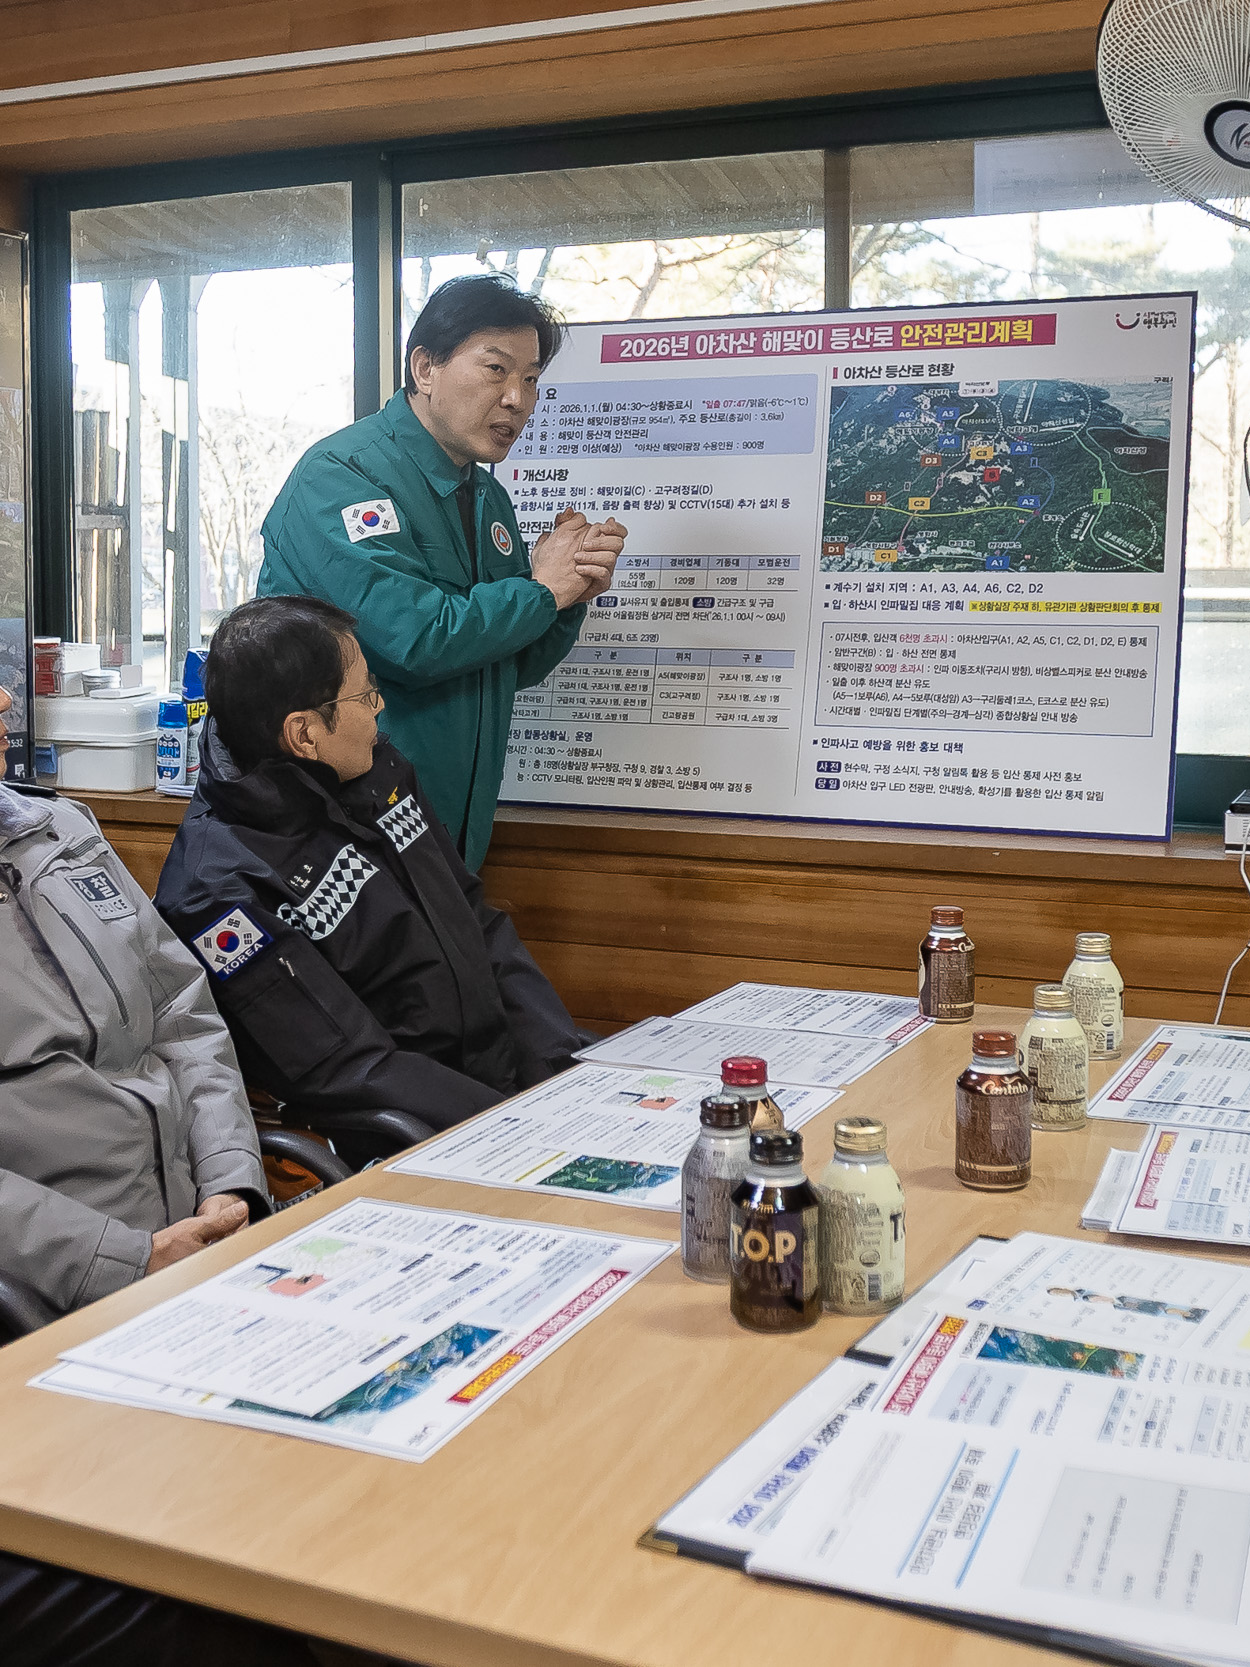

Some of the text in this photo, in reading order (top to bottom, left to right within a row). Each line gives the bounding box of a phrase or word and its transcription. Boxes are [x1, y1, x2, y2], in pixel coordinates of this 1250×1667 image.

[620, 319, 1032, 356] 2026년 아차산 해맞이 등산로 안전관리계획
[844, 363, 954, 379] 아차산 등산로 현황
[545, 388, 557, 400] 요
[559, 402, 612, 412] 2026.1.1.(월)
[615, 399, 692, 411] 04:30~상황종료시
[559, 416, 584, 426] 아차산
[587, 416, 645, 426] 해맞이광장(규모
[678, 413, 696, 423] 주요
[699, 412, 751, 423] 등산로(총길이
[558, 428, 648, 440] 해맞이 등산객 안전관리
[522, 468, 569, 482] 개선사항
[520, 484, 712, 497] 노후 등산로 정비 해맞이길(C) 고구려정길(D)
[520, 501, 554, 511] 음향시설
[602, 500, 618, 510] 음량
[623, 500, 639, 510] 출력
[643, 499, 664, 510] 향상)
[668, 500, 676, 509] 및
[680, 498, 733, 509] CCTV(15대)
[737, 498, 755, 508] 추가
[759, 498, 777, 508] 설치
[781, 498, 790, 508] 등
[519, 521, 556, 534] 안전관
[625, 559, 650, 567] 소방서
[715, 558, 740, 567] 기동대
[757, 558, 791, 568] 모범운전
[833, 582, 1042, 593] 계수기 설치 지역 A1, A3, A4, A6, C2, D2
[880, 600, 918, 610] 인파밀집
[922, 600, 940, 610] 대응
[944, 600, 963, 610] 계획
[835, 633, 870, 642] 07시전후,
[873, 633, 896, 642] 입산객
[922, 634, 947, 643] 초과시
[957, 634, 1013, 644] 아차산입구(A1,
[1016, 635, 1029, 645] A2,
[1032, 636, 1046, 645] A5,
[1049, 636, 1063, 645] C1,
[1066, 636, 1080, 645] C2,
[1083, 636, 1097, 646] D1,
[1100, 637, 1114, 646] D2,
[1117, 636, 1126, 646] E)
[1129, 637, 1146, 646] 통제
[821, 737, 963, 753] 인파사고 예방을 위한 홍보 대책
[842, 780, 1103, 801] 아차산 입구 LED 전광판, 안내방송, 확성기를 활용한 입산 통제 알림
[223, 942, 263, 975] KOREA
[731, 1223, 797, 1264] T.O.P
